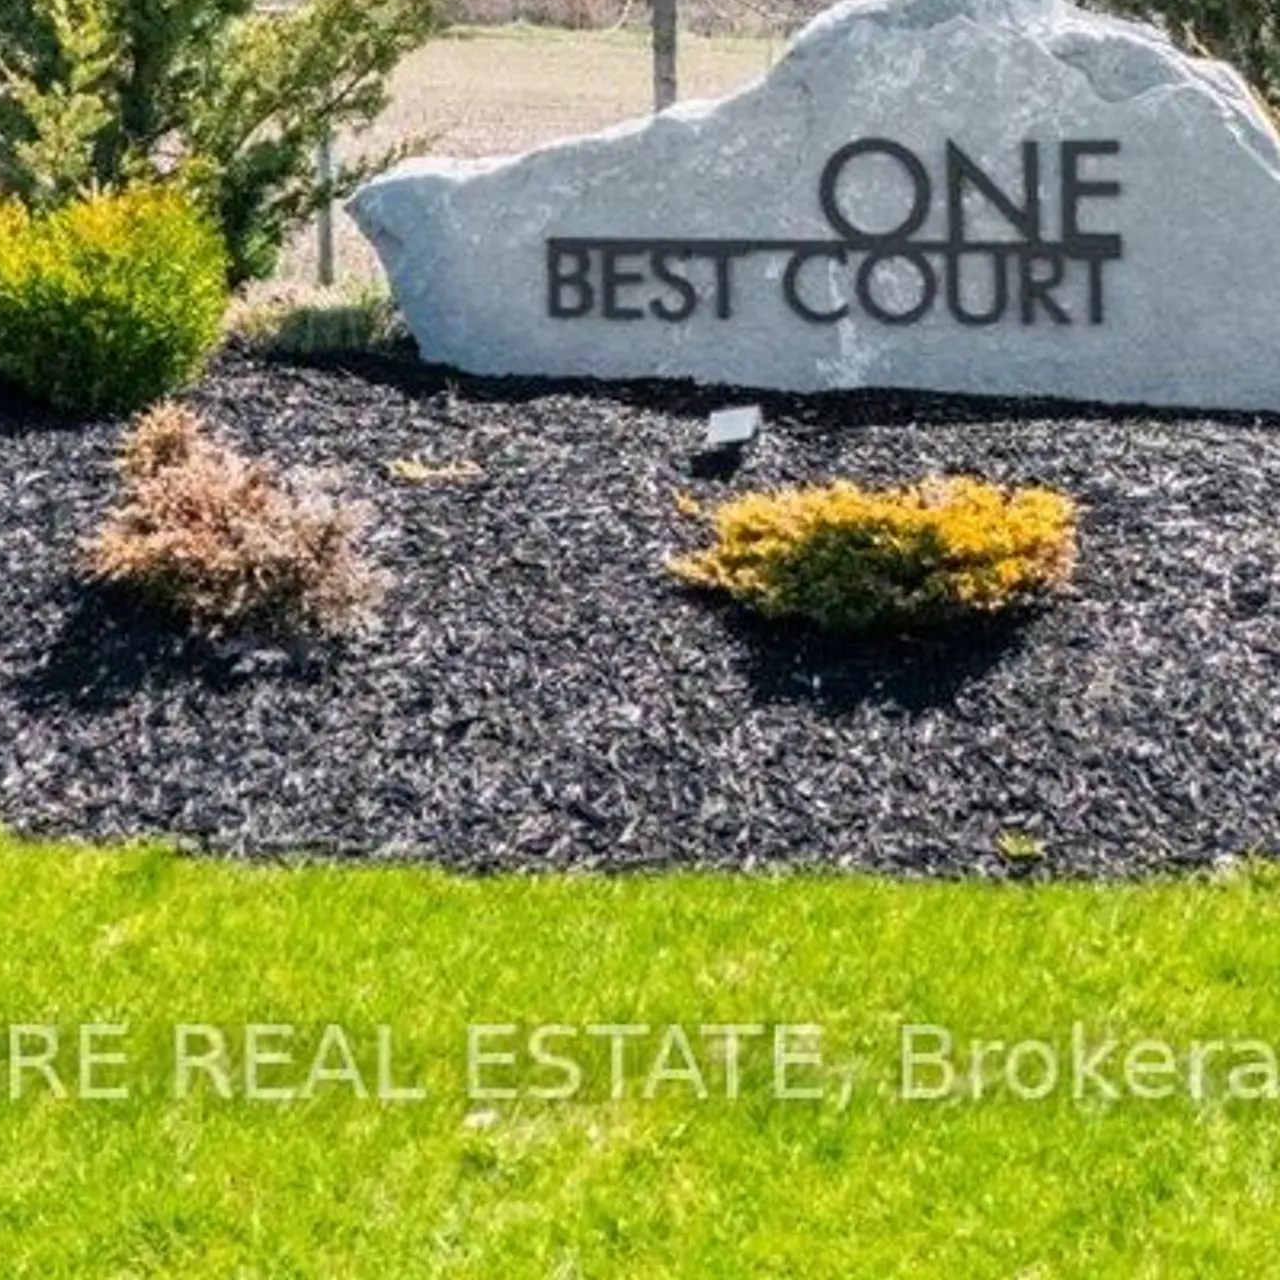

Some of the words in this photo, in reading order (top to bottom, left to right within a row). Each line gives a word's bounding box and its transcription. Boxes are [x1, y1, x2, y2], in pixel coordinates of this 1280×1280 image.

[819, 137, 1121, 246] ONE
[547, 239, 741, 321] BEST
[781, 244, 1109, 325] COURT
